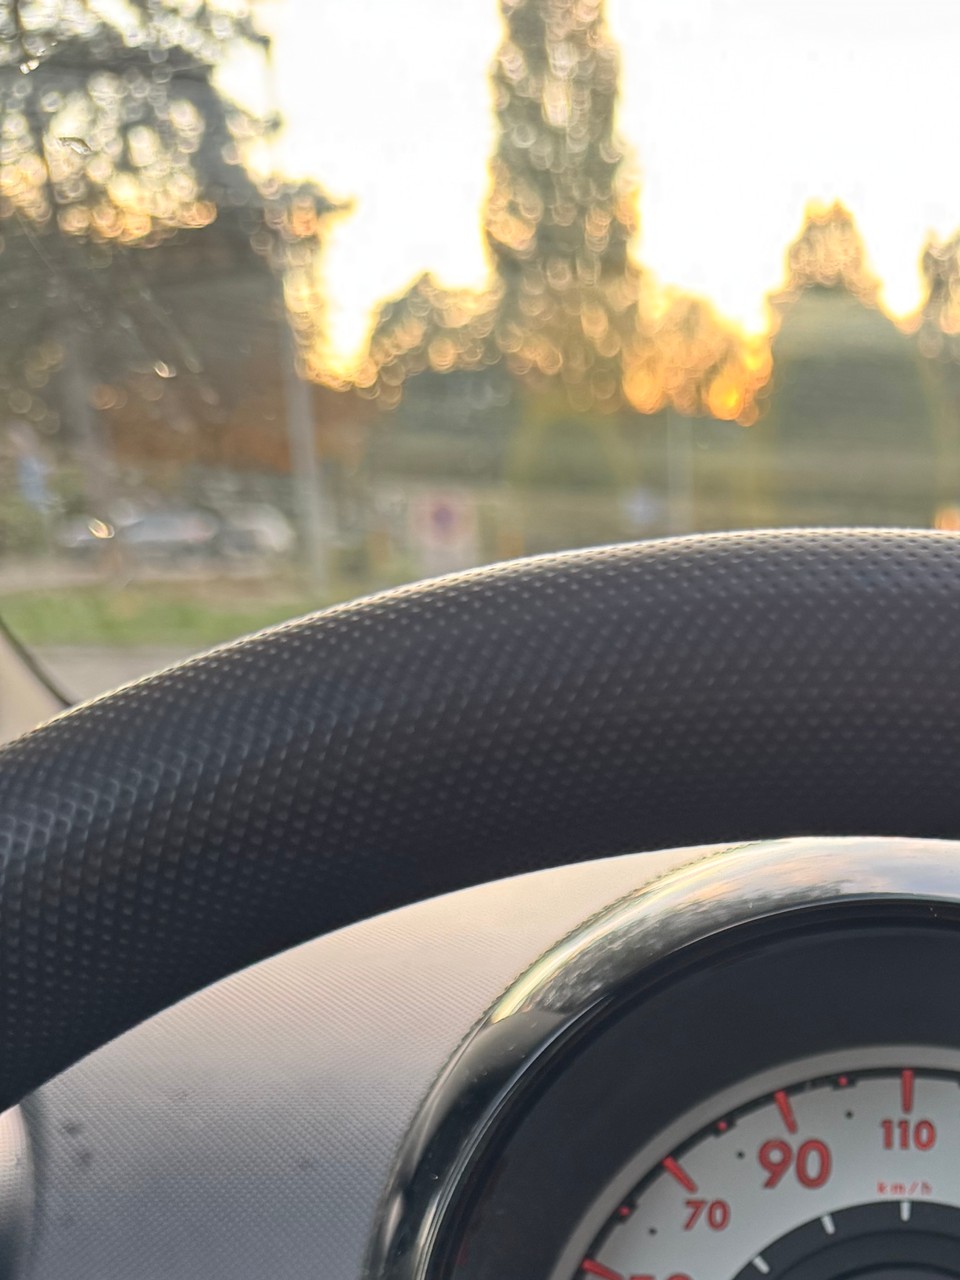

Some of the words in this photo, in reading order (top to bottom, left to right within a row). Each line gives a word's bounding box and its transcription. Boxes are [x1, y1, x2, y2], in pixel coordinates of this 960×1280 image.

[881, 1119, 936, 1150] 110
[757, 1138, 832, 1190] 90
[876, 1181, 933, 1196] km/h
[683, 1199, 731, 1231] 70
